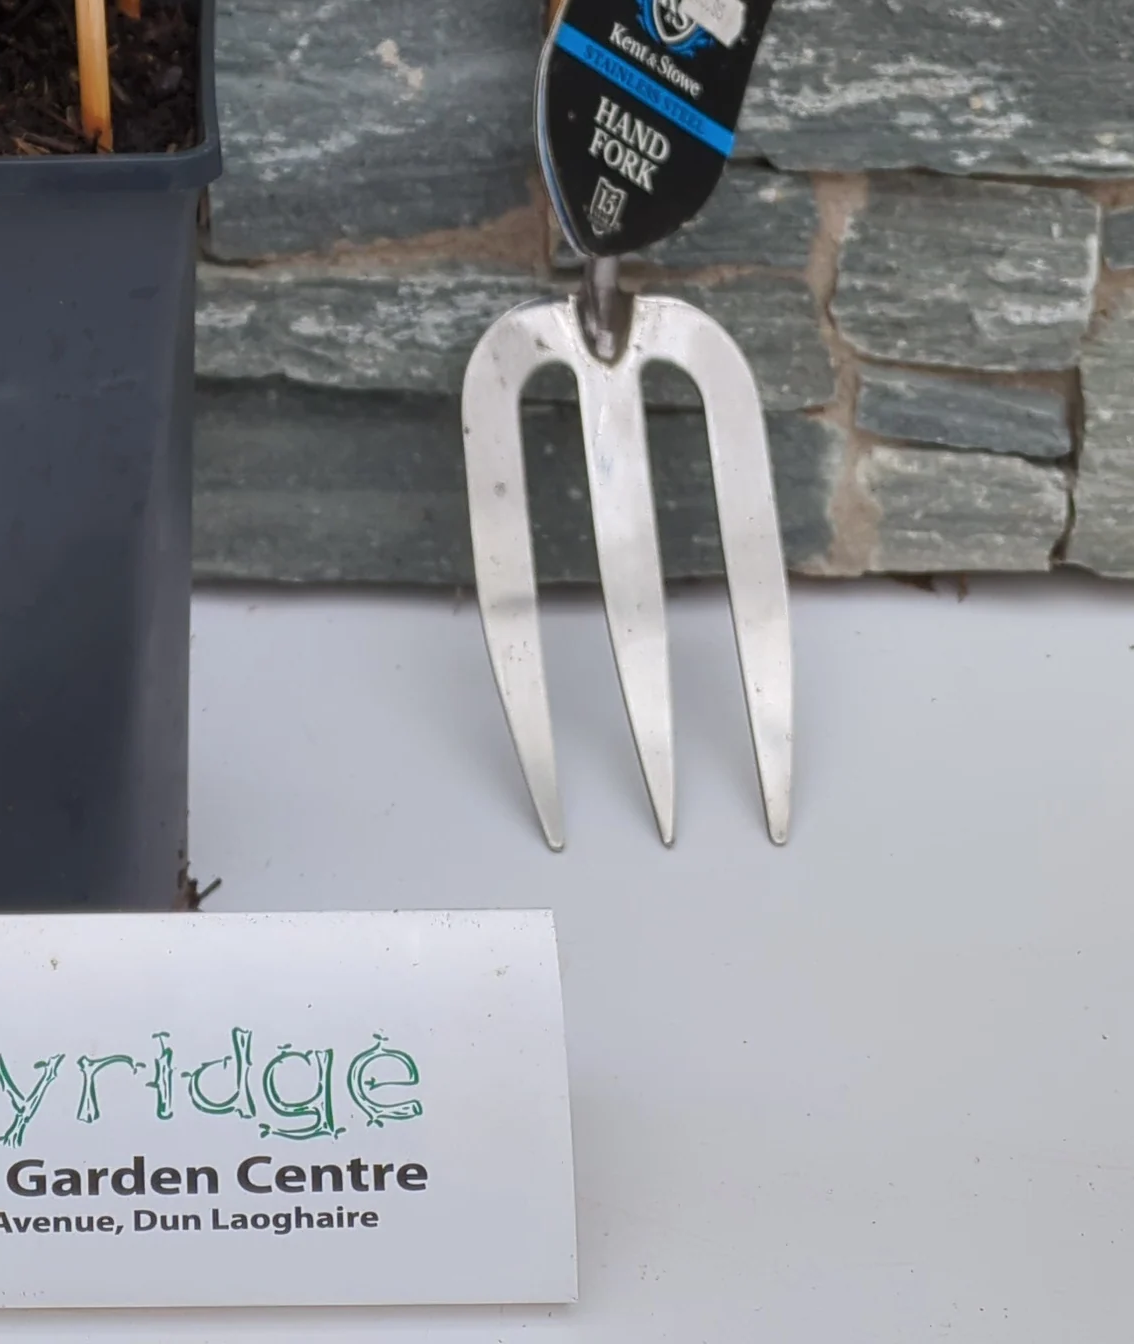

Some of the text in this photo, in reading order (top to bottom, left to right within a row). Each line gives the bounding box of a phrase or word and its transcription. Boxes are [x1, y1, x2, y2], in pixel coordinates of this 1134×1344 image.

[609, 21, 650, 63] Kent
[656, 55, 703, 100] Stowe
[594, 95, 671, 162] HAND
[588, 126, 658, 195] FORK
[597, 188, 618, 215] 15
[5, 1156, 219, 1197] Garden
[236, 1155, 428, 1194] Centre
[133, 1208, 202, 1231] Dun
[211, 1206, 380, 1235] Laoghaire
